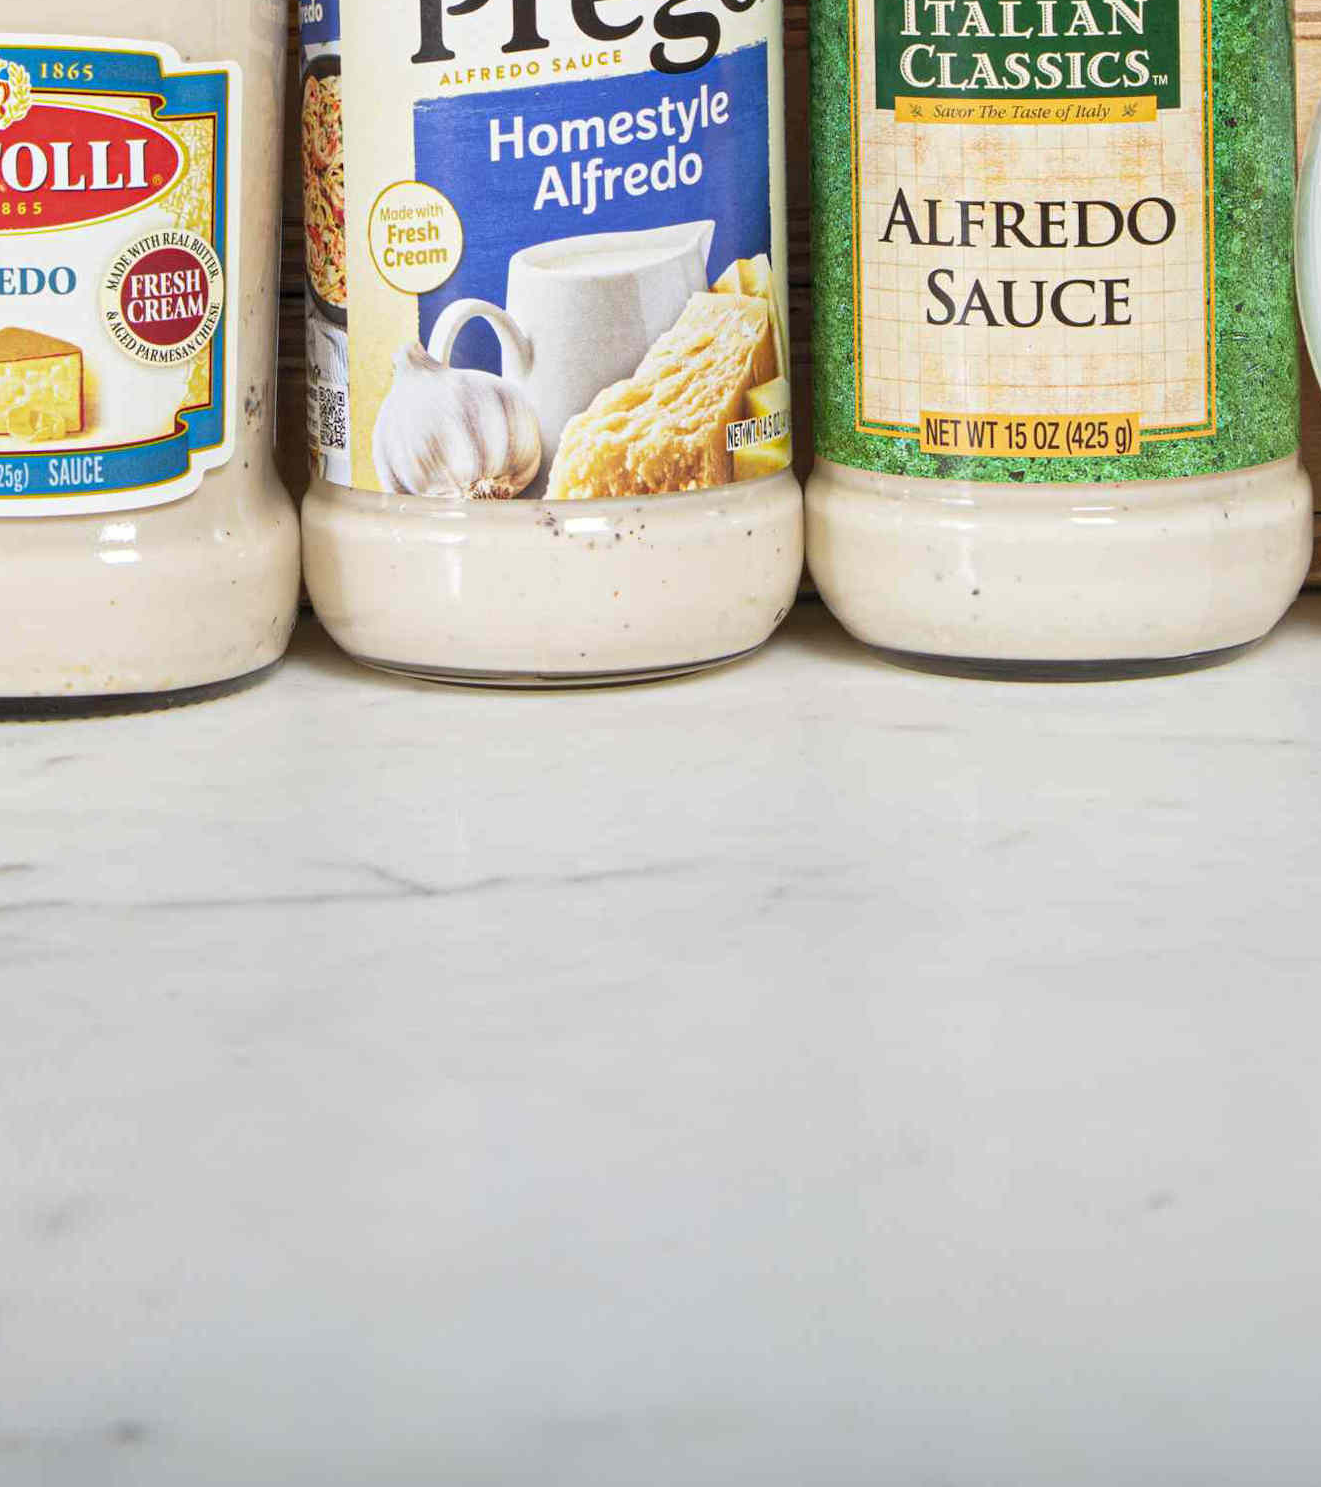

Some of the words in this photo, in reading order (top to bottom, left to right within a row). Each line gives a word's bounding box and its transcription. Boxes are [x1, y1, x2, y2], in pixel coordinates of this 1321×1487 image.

[39, 62, 94, 81] 1865
[440, 60, 540, 85] ALFREDO
[552, 50, 623, 73] SAUCE
[900, 43, 1150, 90] CLASSICS
[489, 84, 730, 162] Homestyle
[933, 103, 973, 119] Savor
[980, 103, 1005, 119] The
[1010, 103, 1050, 120] Taste
[1055, 103, 1070, 121] of
[1074, 102, 1110, 123] Italy
[533, 147, 703, 214] Alfredo
[387, 222, 440, 244] Fresh
[879, 187, 1176, 248] ALFREDO
[106, 255, 131, 290] MADE
[128, 234, 160, 258] WITH
[162, 233, 189, 246] REAL
[383, 244, 448, 268] Cream
[131, 269, 200, 297] FRESH
[926, 268, 1132, 328] SAUCE
[127, 293, 203, 323] CREAM
[49, 455, 104, 486] SAUCE
